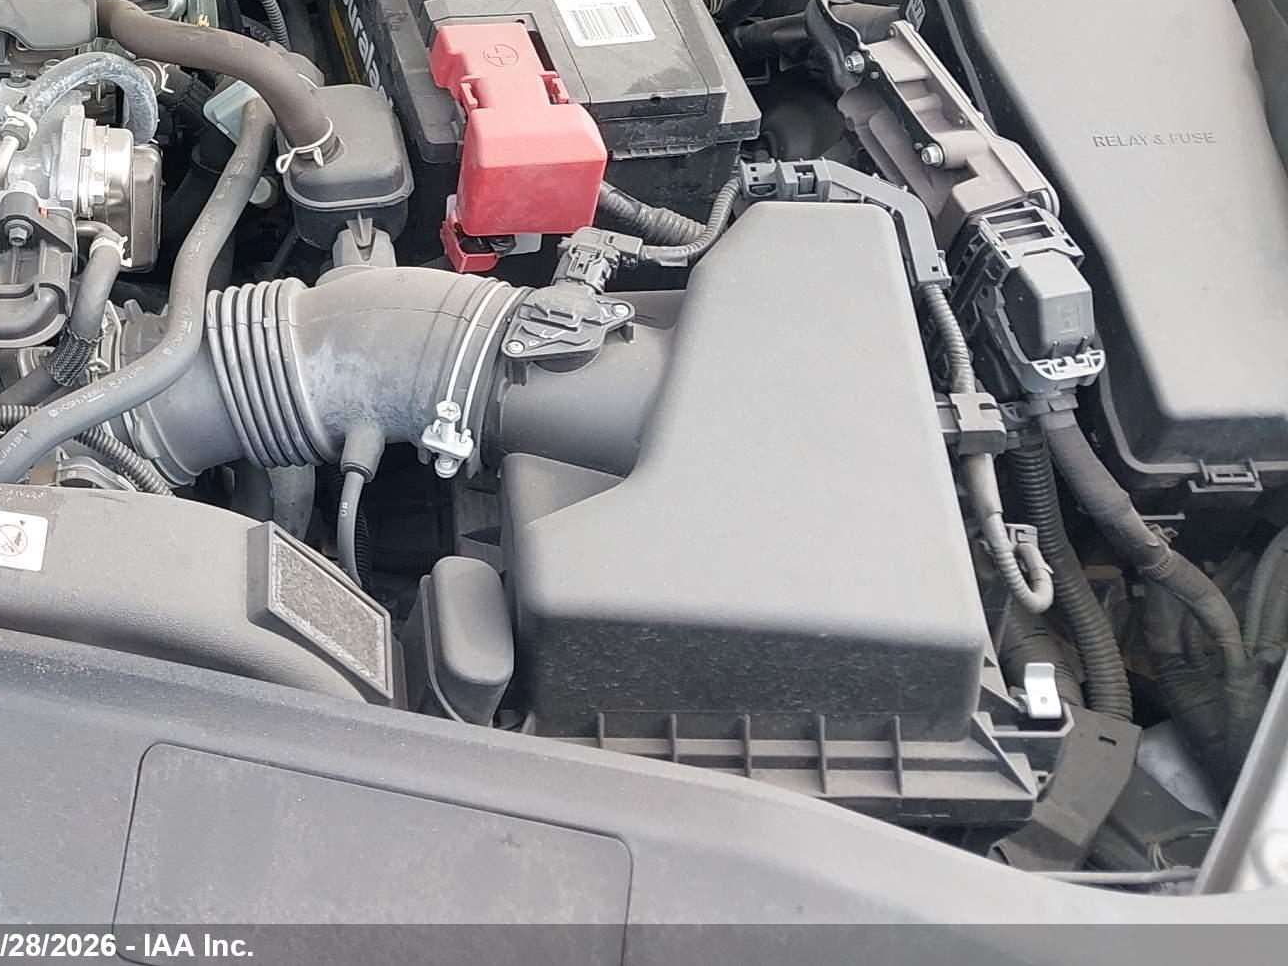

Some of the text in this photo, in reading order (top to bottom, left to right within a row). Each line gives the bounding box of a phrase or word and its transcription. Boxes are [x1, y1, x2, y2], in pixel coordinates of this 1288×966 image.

[1093, 132, 1216, 148] RELAY & FUSE
